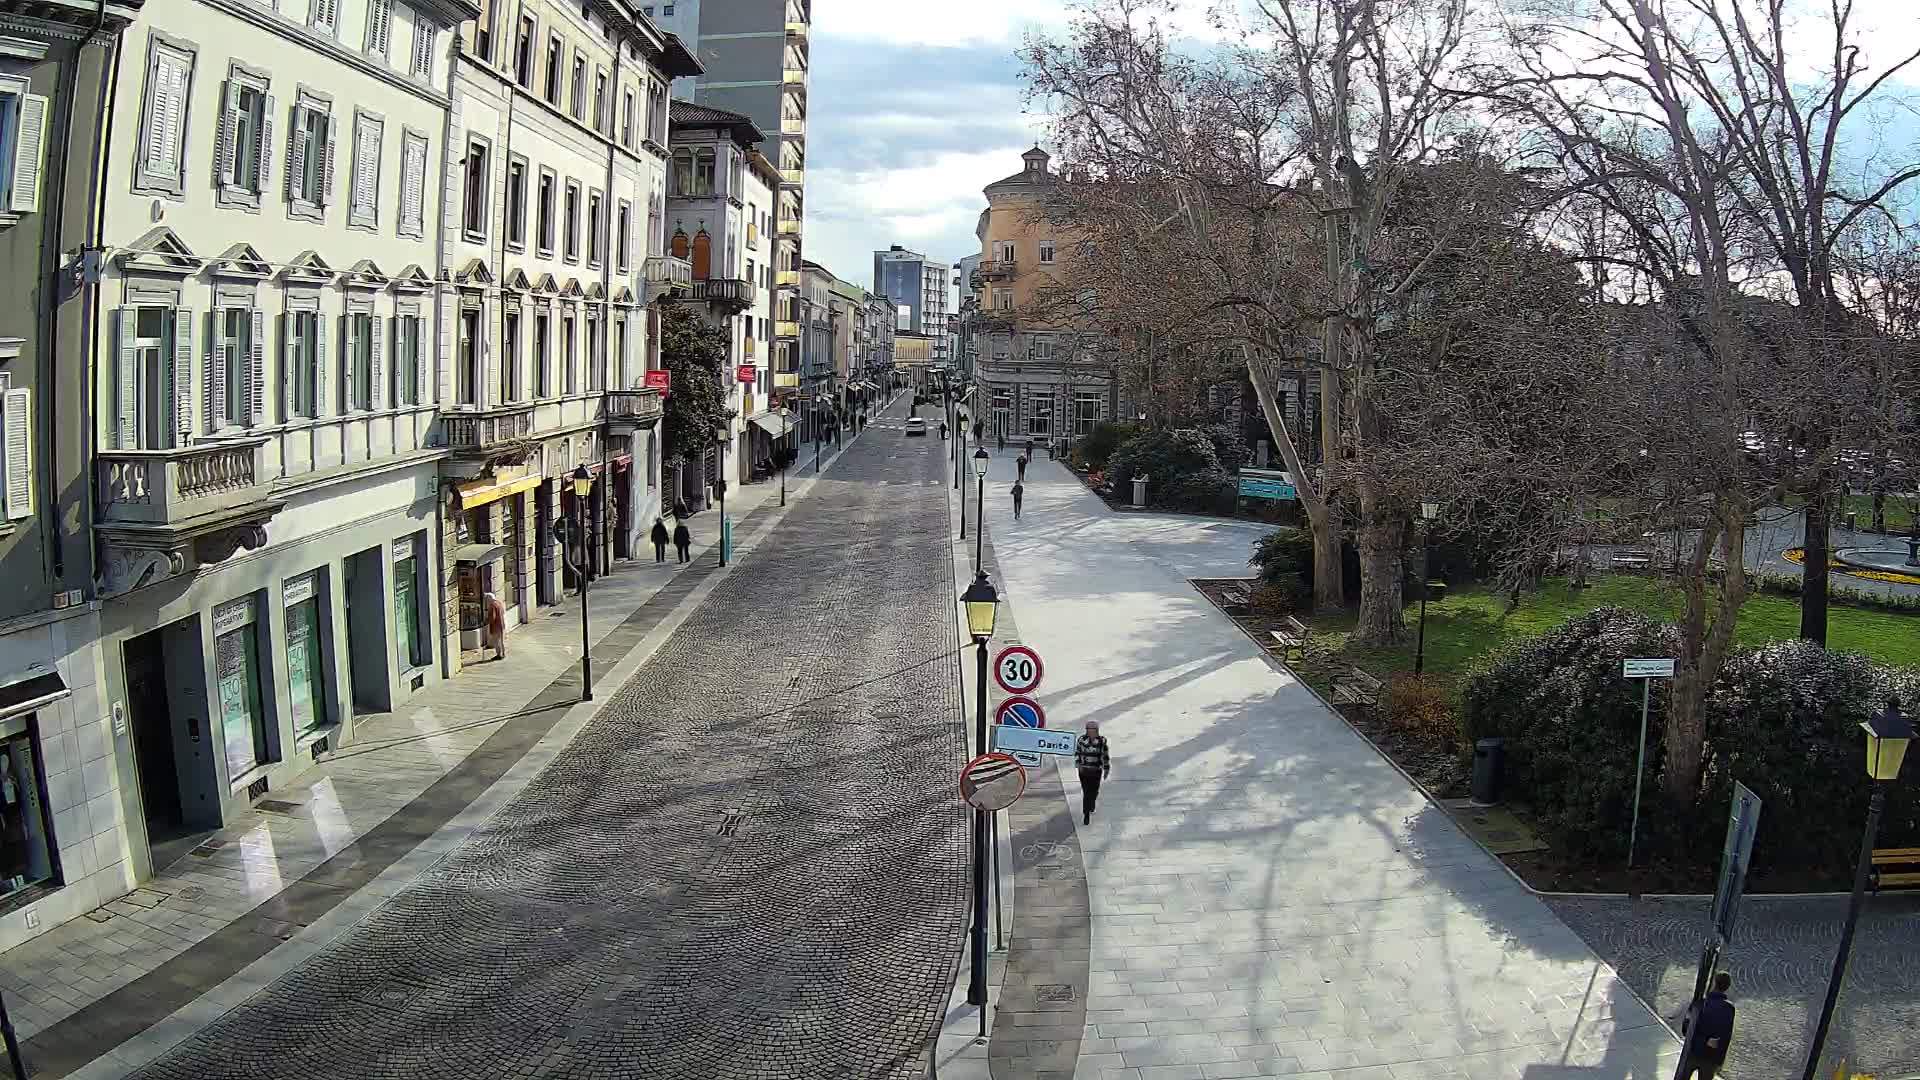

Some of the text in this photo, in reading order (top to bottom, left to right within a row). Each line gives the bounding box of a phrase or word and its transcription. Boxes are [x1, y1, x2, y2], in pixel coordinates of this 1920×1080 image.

[1005, 659, 1032, 681] 30
[221, 678, 240, 701] 130
[1038, 739, 1070, 750] Dante
